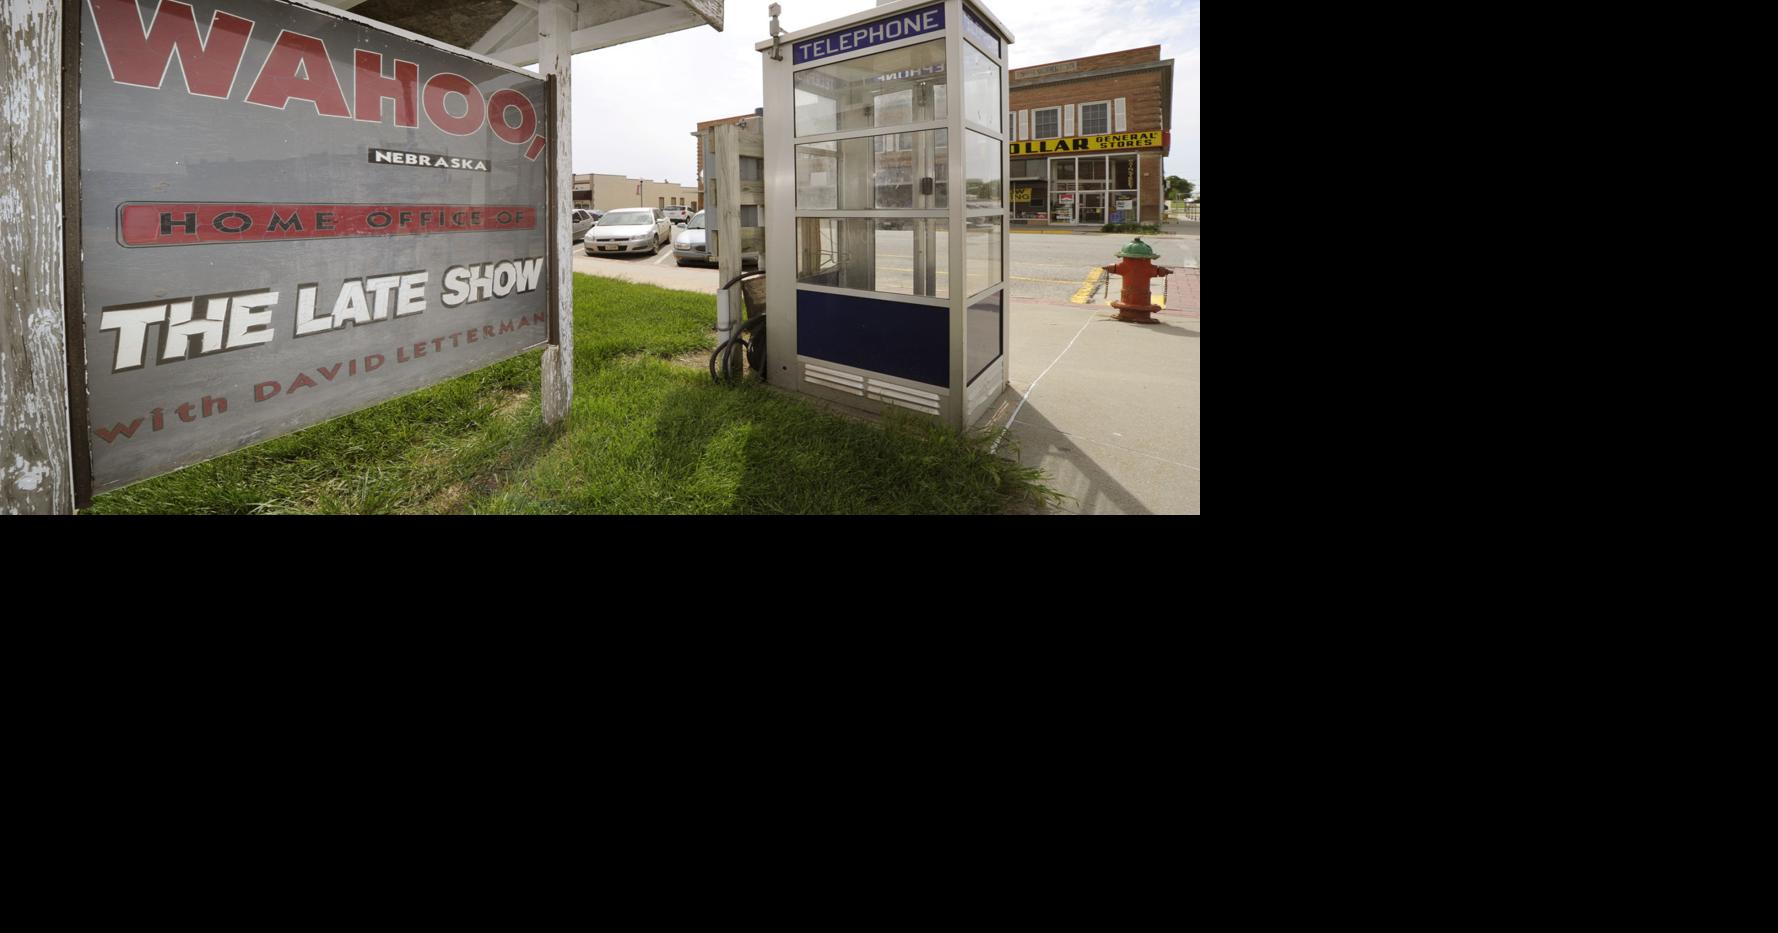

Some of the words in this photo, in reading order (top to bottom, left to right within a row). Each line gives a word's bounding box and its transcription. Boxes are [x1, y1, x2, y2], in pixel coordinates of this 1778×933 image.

[799, 9, 940, 61] TELEPHONE
[87, 0, 546, 162] WAHOO,
[1096, 132, 1156, 143] GENERAL
[1100, 139, 1153, 149] STORES
[374, 149, 489, 172] NEBRASKA
[159, 210, 336, 236] HOME
[366, 209, 482, 230] OFFICE
[496, 210, 526, 225] OF
[99, 288, 281, 374] THE
[294, 270, 429, 338] LATE
[441, 257, 544, 308] SHOW
[93, 394, 229, 444] with
[253, 352, 386, 403] DAVID
[397, 312, 545, 365] LETTERMAN
